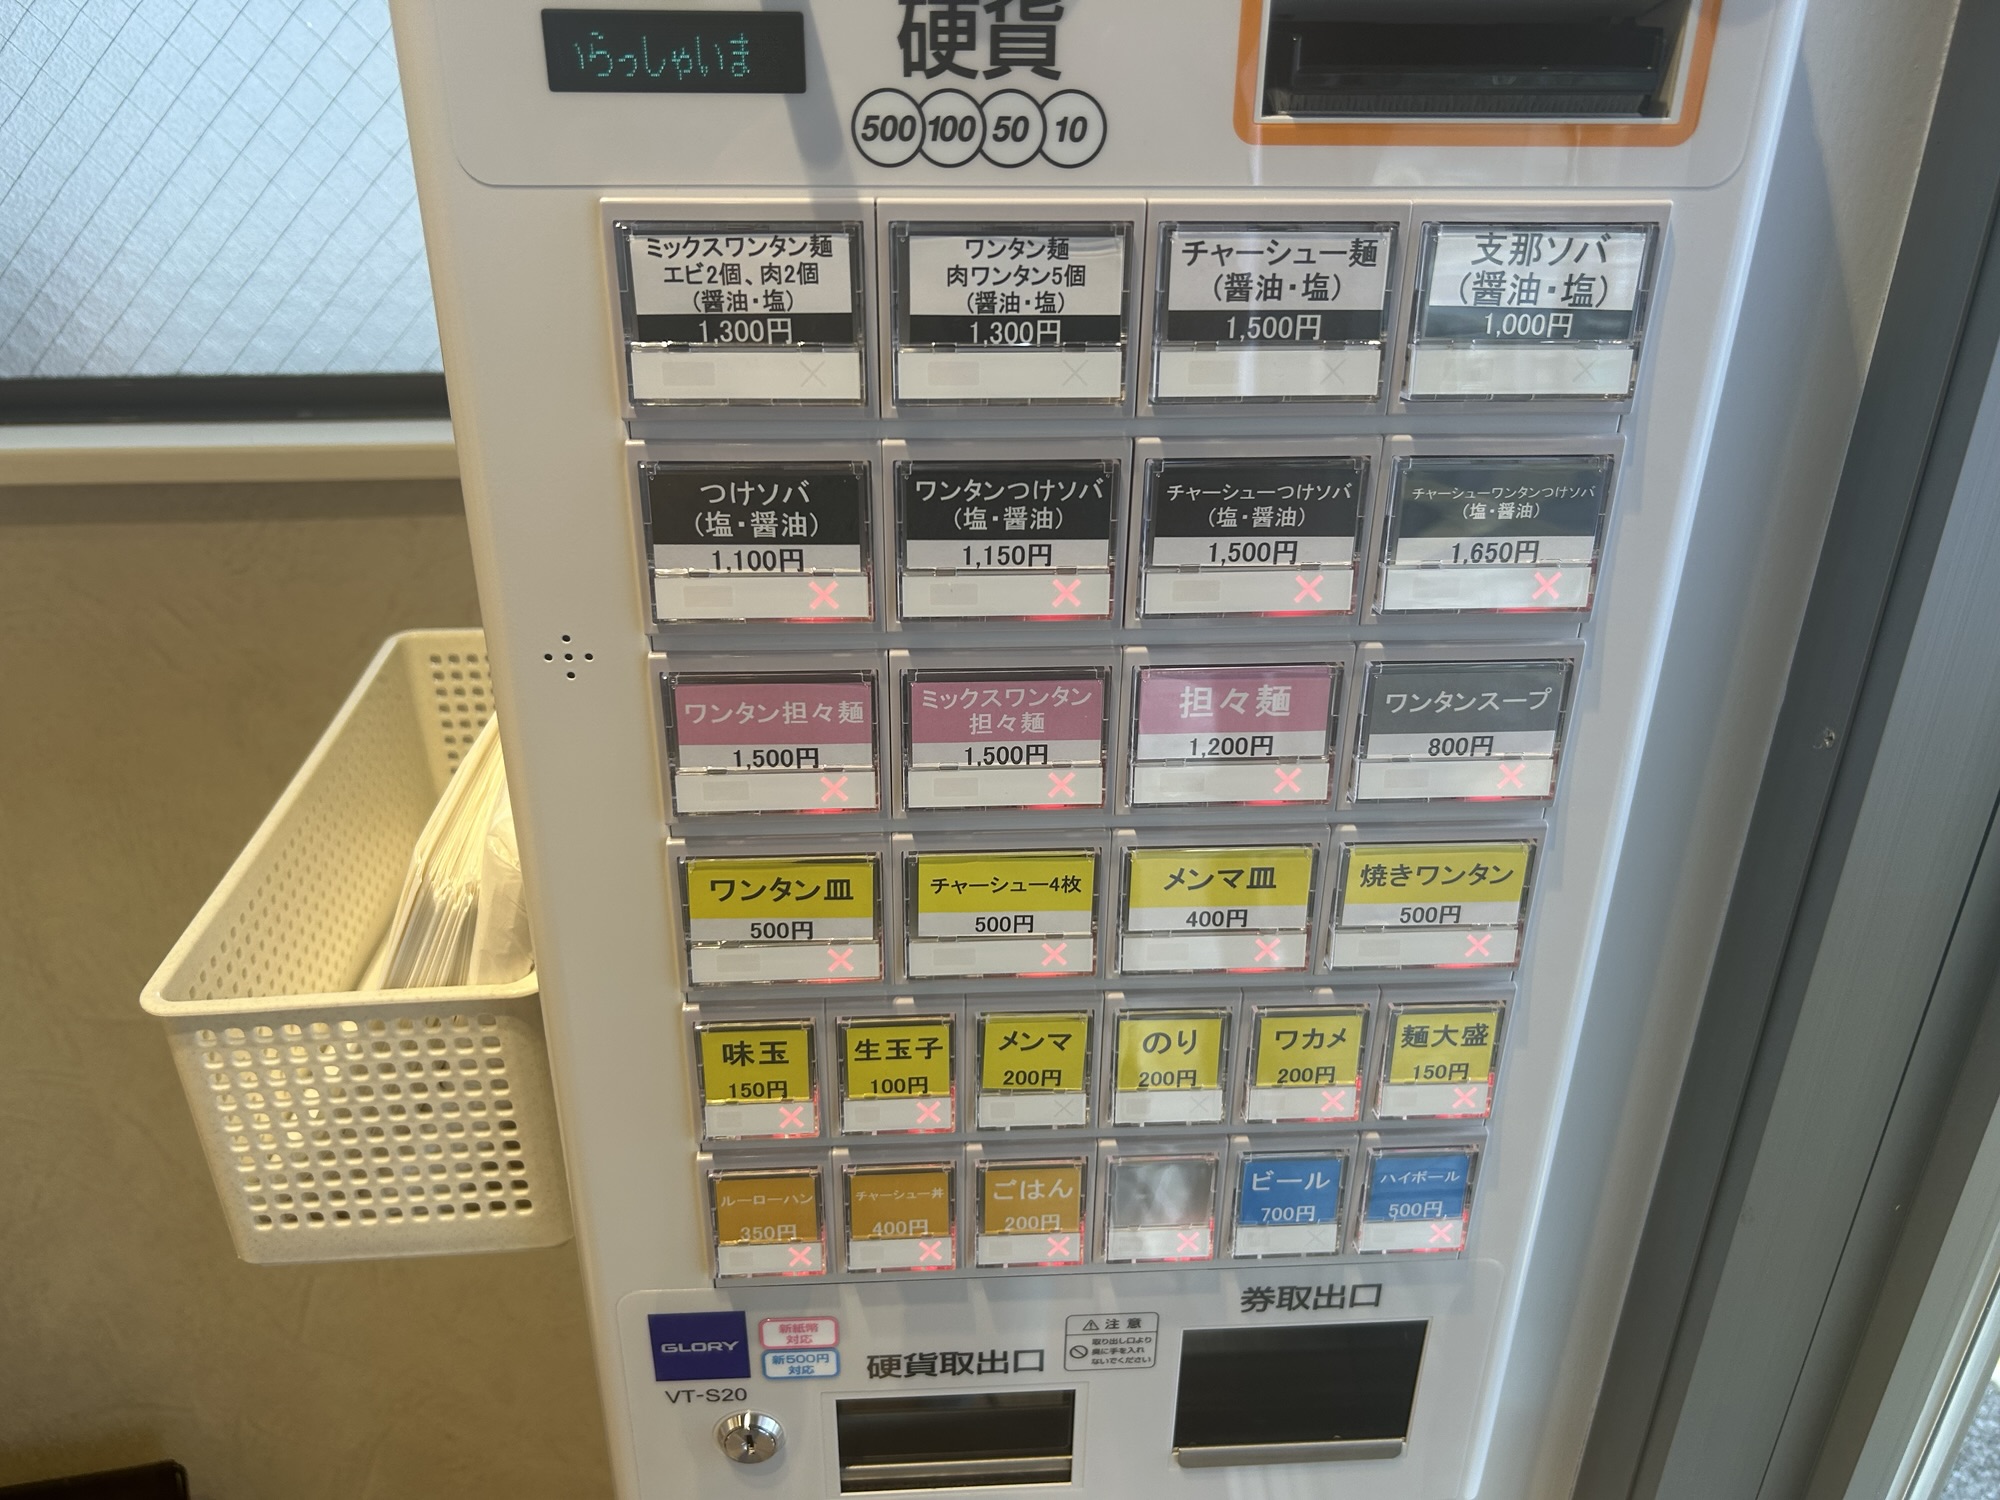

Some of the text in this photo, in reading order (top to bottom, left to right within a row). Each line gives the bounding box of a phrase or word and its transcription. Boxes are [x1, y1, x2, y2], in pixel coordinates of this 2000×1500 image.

[897, 0, 1064, 80] 硬貨
[861, 114, 1088, 143] 500 100 50 10
[647, 235, 833, 258] ミックスワンタン麺
[965, 237, 1070, 261] ワンタン麺
[1181, 237, 1379, 267] チャーシュー麺
[1475, 232, 1611, 266] 支那ソバ
[663, 262, 819, 286] エビ2個、肉2個
[946, 264, 1086, 288] 肉ワンタン5個
[1213, 272, 1342, 303] (醤油・塩)
[1459, 270, 1608, 307] (醤油・塩)
[694, 290, 795, 313] (醤油・塩)
[967, 290, 1065, 315] (醤油・塩)
[698, 318, 793, 344] 1,300円
[969, 319, 1062, 345] 1,300円
[1226, 313, 1322, 341] 1,500円
[1484, 312, 1574, 338] 1,000円
[700, 480, 810, 505] つけソバ
[916, 478, 1105, 502] ワンタンつけソバ
[1166, 483, 1352, 502] チャーシューつけソバ
[1412, 485, 1595, 500] チャーシューワンタンつけソバ
[954, 506, 1064, 531] (塩・醤油)
[1208, 507, 1306, 529] (塩・醤油)
[1462, 502, 1541, 520] (塩・醤油)
[695, 510, 819, 538] (塩・醤油)
[712, 549, 804, 573] 1,100円
[962, 544, 1053, 567] 1,150円
[1208, 541, 1299, 565] 1,500円
[1451, 540, 1539, 564] 1,650円
[922, 686, 1092, 710] ミックスワンタン
[1180, 684, 1292, 719] 担々麺
[1385, 687, 1553, 714] ワンタンスープ
[684, 701, 864, 725] ワンタン担々麺
[969, 712, 1045, 735] 担々麺
[964, 743, 1048, 766] 1,500円
[1190, 735, 1274, 758] 1,200円
[1428, 735, 1494, 757] 800円
[733, 748, 820, 770] 1,500円
[930, 875, 1082, 895] チャーシュー4枚
[1163, 866, 1276, 891] メンマ皿
[1360, 863, 1513, 888] 焼きワンタン
[710, 878, 854, 903] ワンタン皿
[975, 915, 1034, 934] 500円
[1186, 909, 1248, 928] 400円
[1400, 905, 1461, 924] 500円
[750, 921, 814, 941] 500円
[999, 1030, 1073, 1052] メンマ
[1142, 1029, 1199, 1055] のり
[1275, 1027, 1347, 1050] ワカメ
[1401, 1023, 1490, 1048] 麺大盛
[722, 1040, 789, 1066] 味玉
[854, 1037, 944, 1061] 生玉子
[1003, 1069, 1062, 1087] 200円
[1139, 1069, 1197, 1088] 200円
[1277, 1065, 1336, 1084] 200円
[1413, 1062, 1469, 1081] 150円
[728, 1080, 788, 1099] 150円
[871, 1076, 928, 1095] 100円
[1252, 1170, 1330, 1192] ビール
[1380, 1170, 1460, 1184] ハイボール
[721, 1193, 814, 1207] ルーローハン
[855, 1188, 945, 1201] チャーシュー丼
[993, 1179, 1074, 1201] ごはん
[1261, 1206, 1316, 1223] 700円
[1388, 1201, 1443, 1218] 500円
[740, 1224, 797, 1241] 350円
[872, 1218, 929, 1236] 400円
[1005, 1214, 1060, 1231] 200円
[1240, 1283, 1383, 1313] 券取出口
[661, 1340, 739, 1353] GLORY
[786, 1334, 813, 1345] 対応
[1092, 1336, 1152, 1346] 取り出し口より
[772, 1353, 830, 1365] 新500円
[788, 1365, 815, 1375] 対応
[866, 1349, 1045, 1379] 硬貨取出口
[1091, 1356, 1151, 1365] ないでください
[665, 1387, 747, 1404] VT-S20
